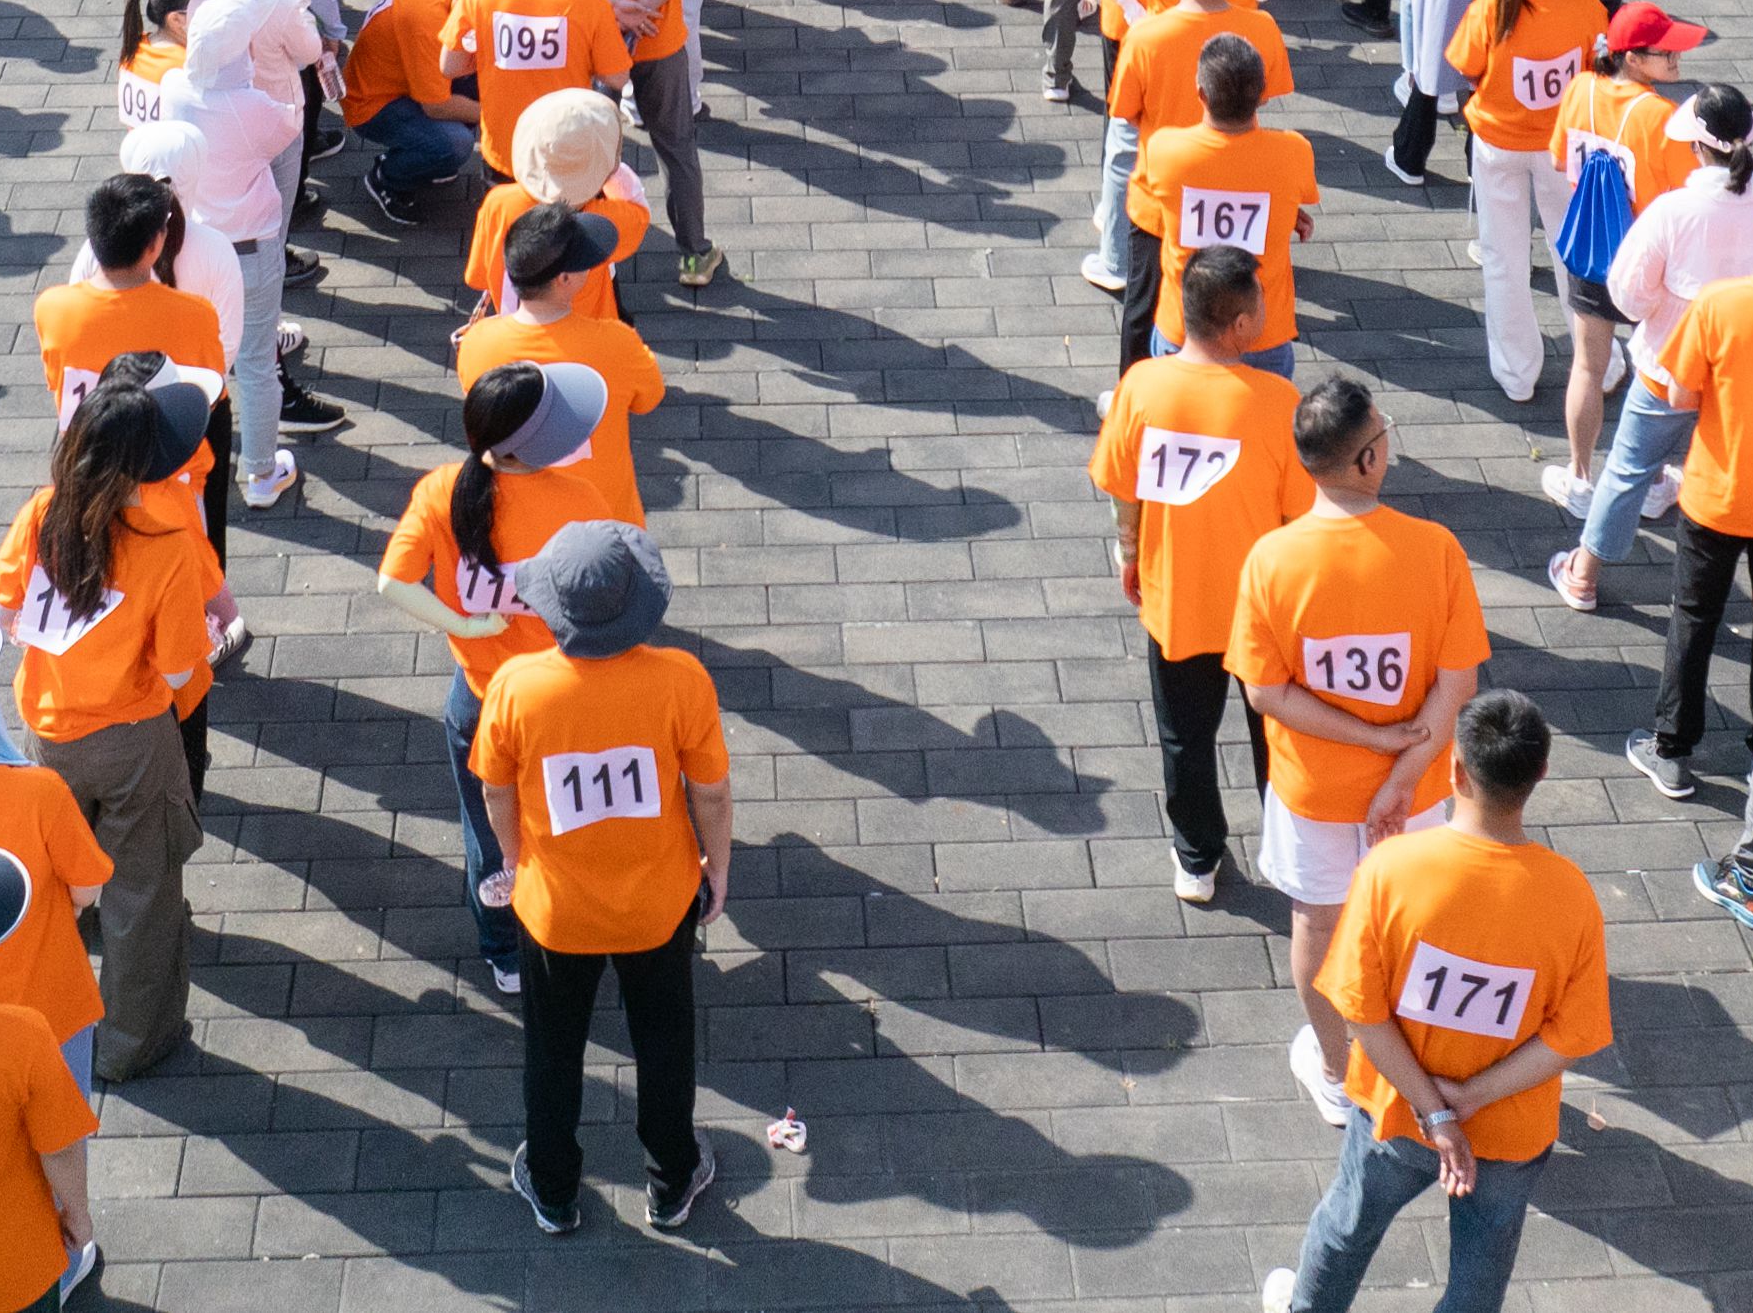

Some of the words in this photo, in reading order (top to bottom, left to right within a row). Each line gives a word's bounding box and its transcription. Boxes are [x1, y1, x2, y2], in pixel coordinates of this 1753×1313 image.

[499, 23, 560, 61] 095
[1522, 59, 1577, 96] 161
[1191, 197, 1262, 242] 167
[1316, 645, 1405, 694] 136
[563, 757, 644, 813] 111
[1422, 965, 1519, 1025] 171
